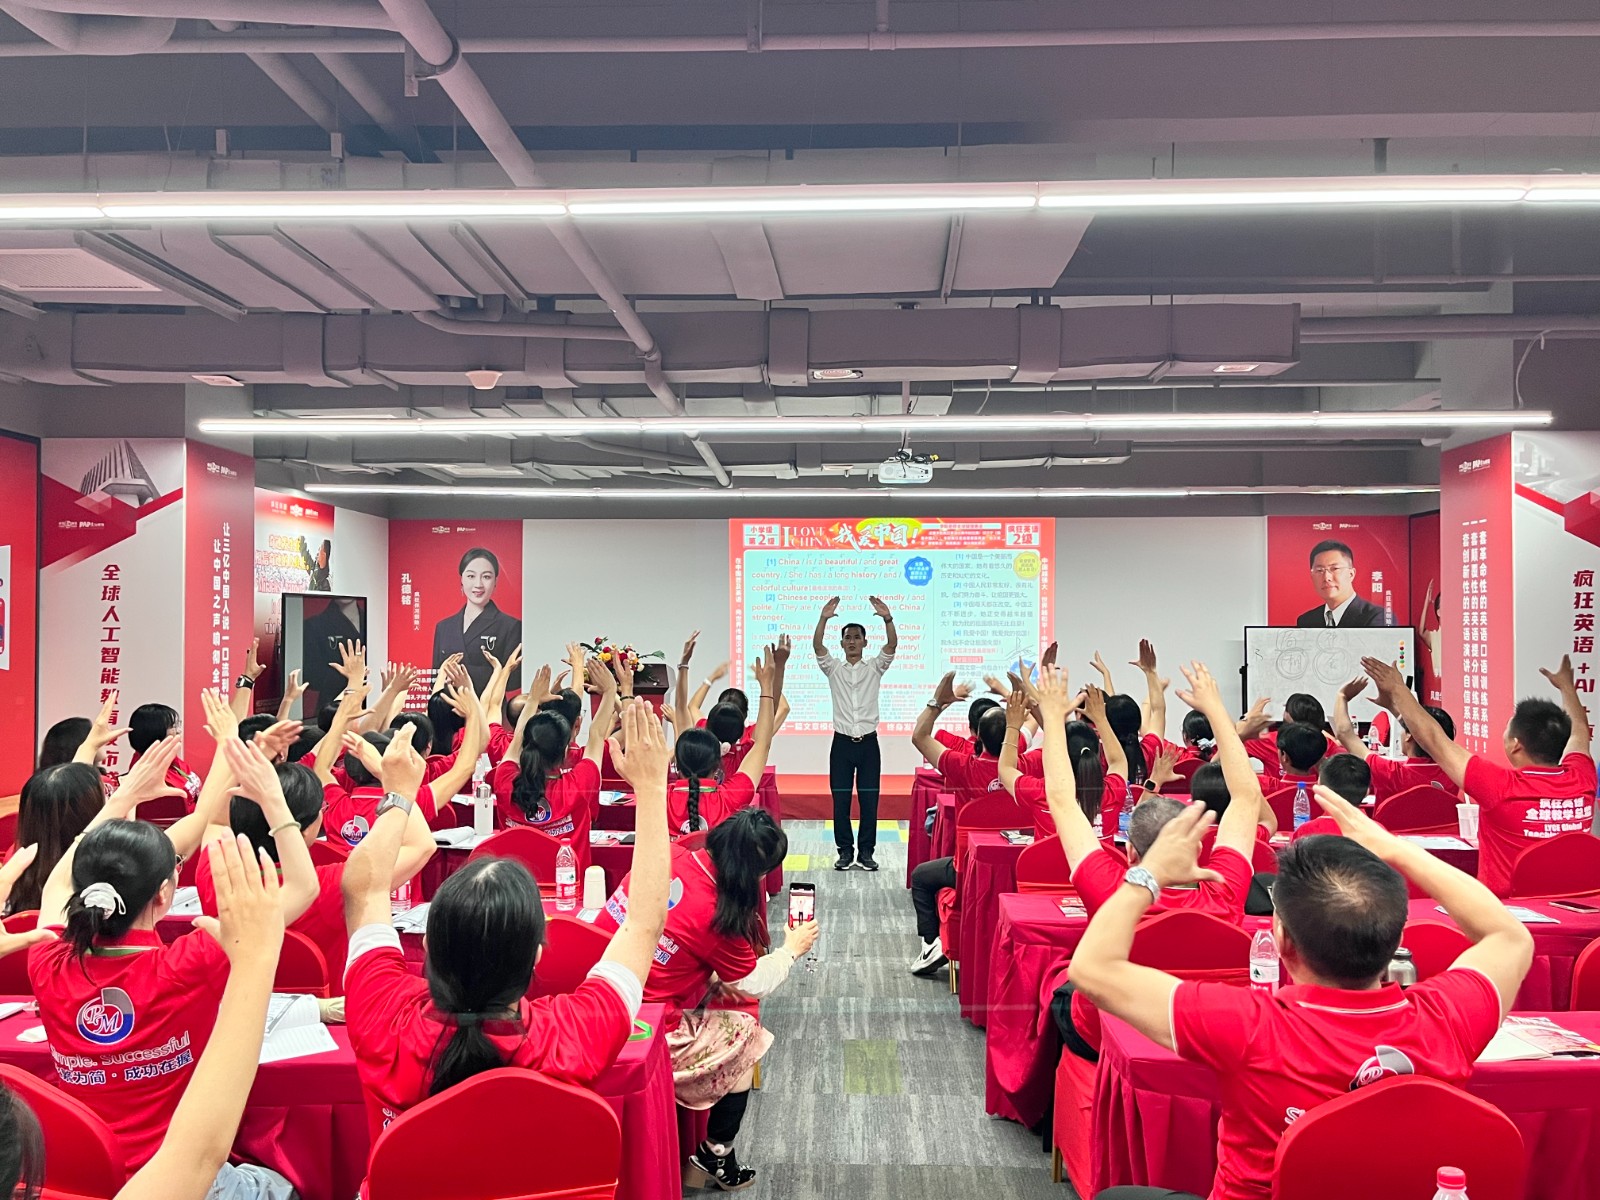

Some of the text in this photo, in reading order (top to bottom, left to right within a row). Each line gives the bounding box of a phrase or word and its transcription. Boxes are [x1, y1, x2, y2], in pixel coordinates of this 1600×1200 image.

[879, 559, 899, 567] great
[834, 571, 850, 579] long
[851, 571, 878, 579] history
[1371, 571, 1383, 593] 李阳
[751, 584, 780, 592] colorful
[782, 604, 798, 612] They
[779, 623, 801, 631] China
[898, 623, 921, 631] China
[101, 1031, 191, 1066] Successful
